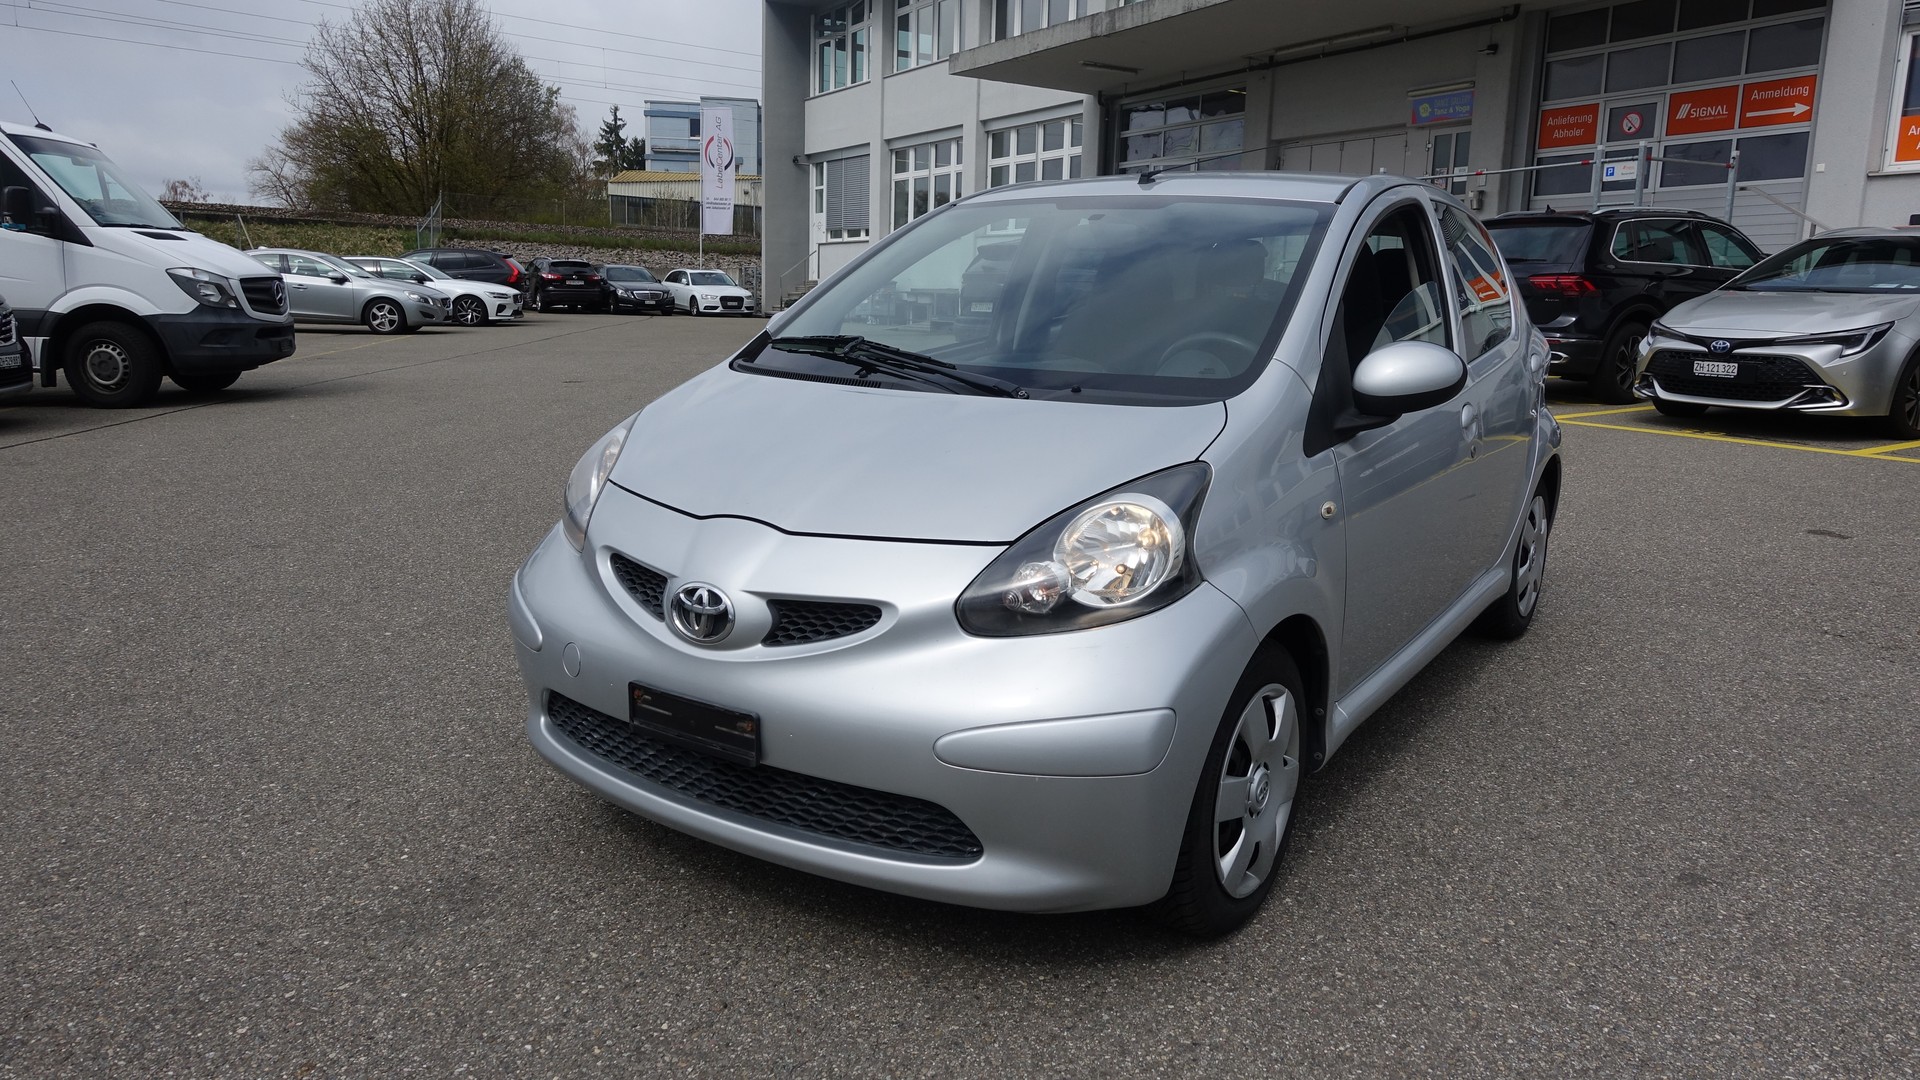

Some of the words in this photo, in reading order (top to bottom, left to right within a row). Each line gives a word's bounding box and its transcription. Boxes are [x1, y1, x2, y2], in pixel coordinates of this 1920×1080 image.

[1751, 85, 1810, 101] Anmeldung
[1455, 105, 1470, 113] Yoga
[1690, 105, 1729, 118] SIGNAL
[716, 116, 722, 131] AG
[1546, 114, 1593, 127] Anlieferung
[1553, 127, 1585, 139] Abholer
[716, 134, 724, 189] LabelCenter
